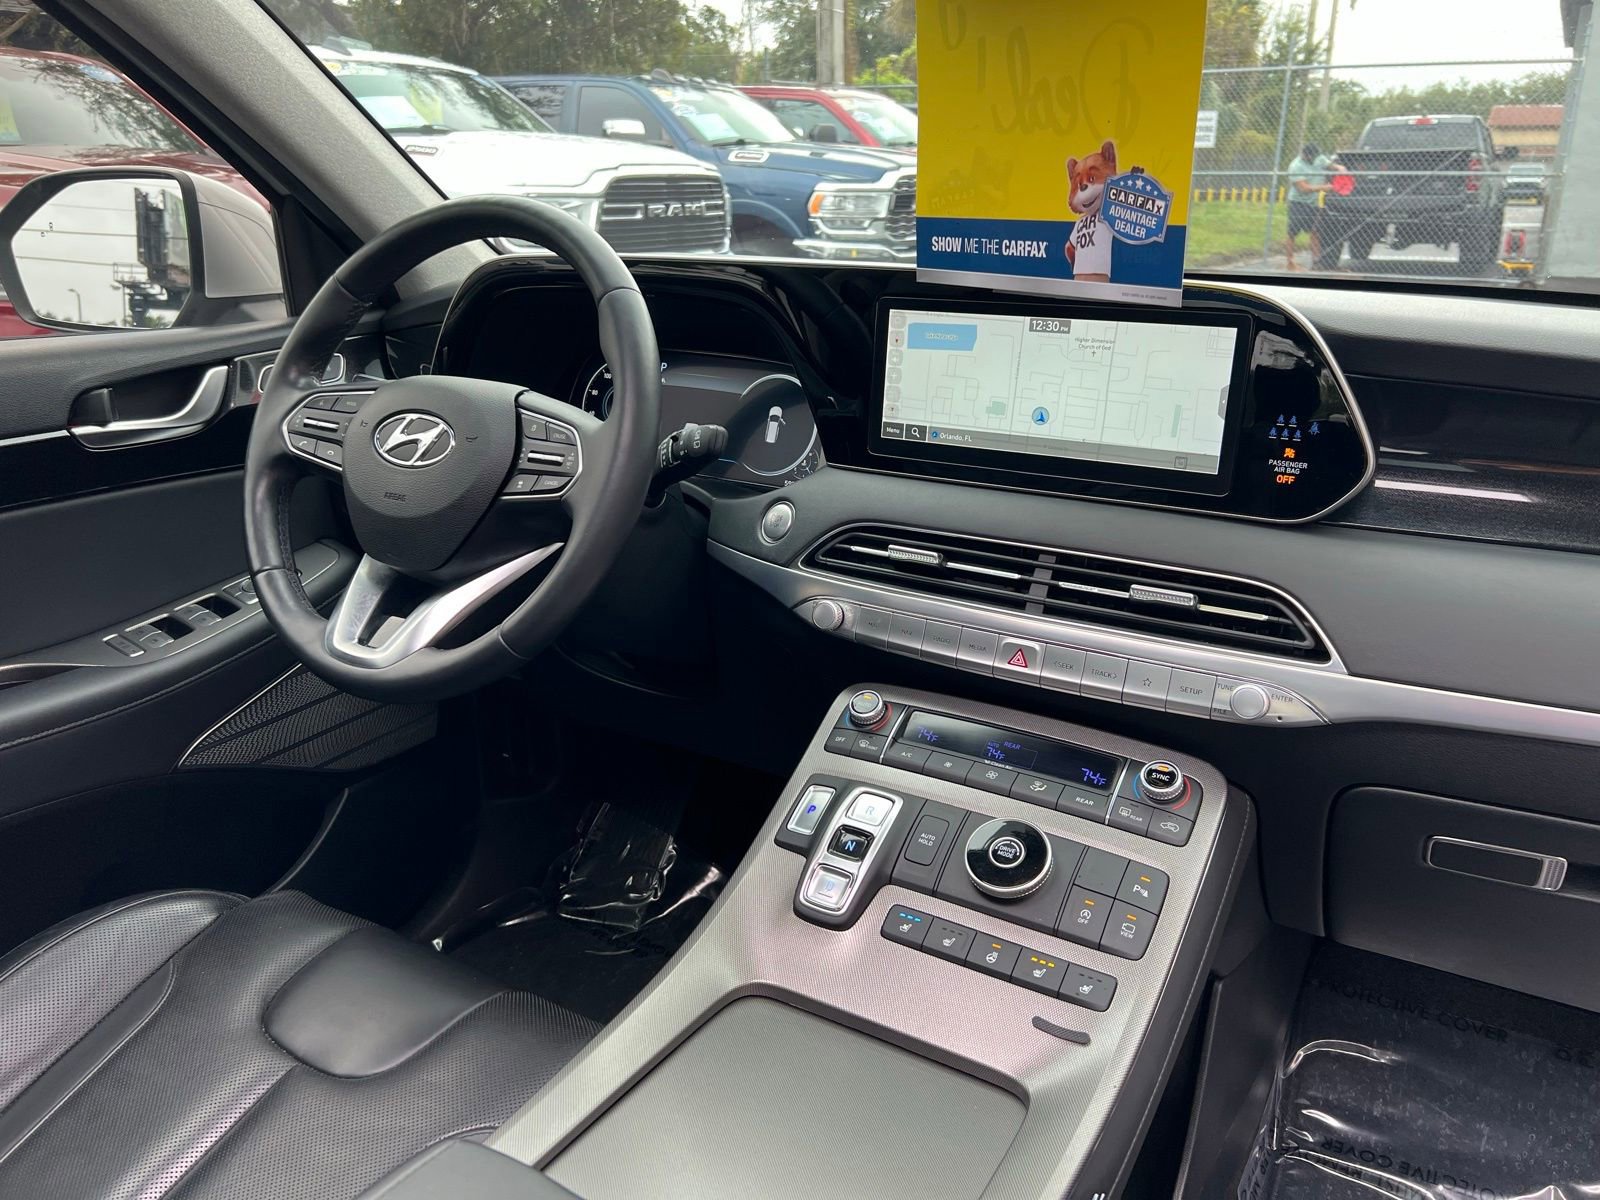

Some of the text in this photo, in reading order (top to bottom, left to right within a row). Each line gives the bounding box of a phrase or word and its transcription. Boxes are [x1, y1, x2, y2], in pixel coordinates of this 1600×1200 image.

[1109, 187, 1164, 216] CARFAX
[646, 201, 703, 217] RAM
[1109, 205, 1157, 228] ADVANTAGE
[1077, 214, 1096, 233] CAR
[1115, 220, 1146, 238] DEALER
[1077, 231, 1095, 248] FOX
[932, 236, 1048, 258] SHOW ME THE CARFAX
[1032, 320, 1059, 331] 12:30
[661, 363, 667, 372] P
[940, 433, 963, 441] Orlando,
[1269, 459, 1308, 469] PASSENGER
[1286, 467, 1300, 475] BAG
[1277, 475, 1296, 484] OFF
[969, 644, 987, 652] MEDIA
[1180, 685, 1203, 695] SETUP
[1217, 683, 1234, 691] TUNE
[1271, 694, 1294, 703] ENTER
[1003, 741, 1021, 750] REAR
[1151, 772, 1170, 781] SYNC
[1075, 797, 1094, 806] REAR
[807, 805, 816, 814] P
[865, 806, 874, 815] R
[921, 833, 935, 841] AUTO
[845, 840, 855, 852] N
[918, 838, 933, 846] HOLD
[999, 845, 1016, 854] DRIVE
[997, 850, 1014, 859] MODE
[1120, 931, 1134, 939] VIEW
[1318, 979, 1508, 1043] PROTECTIVE COVER
[1320, 1136, 1394, 1170] COVER
